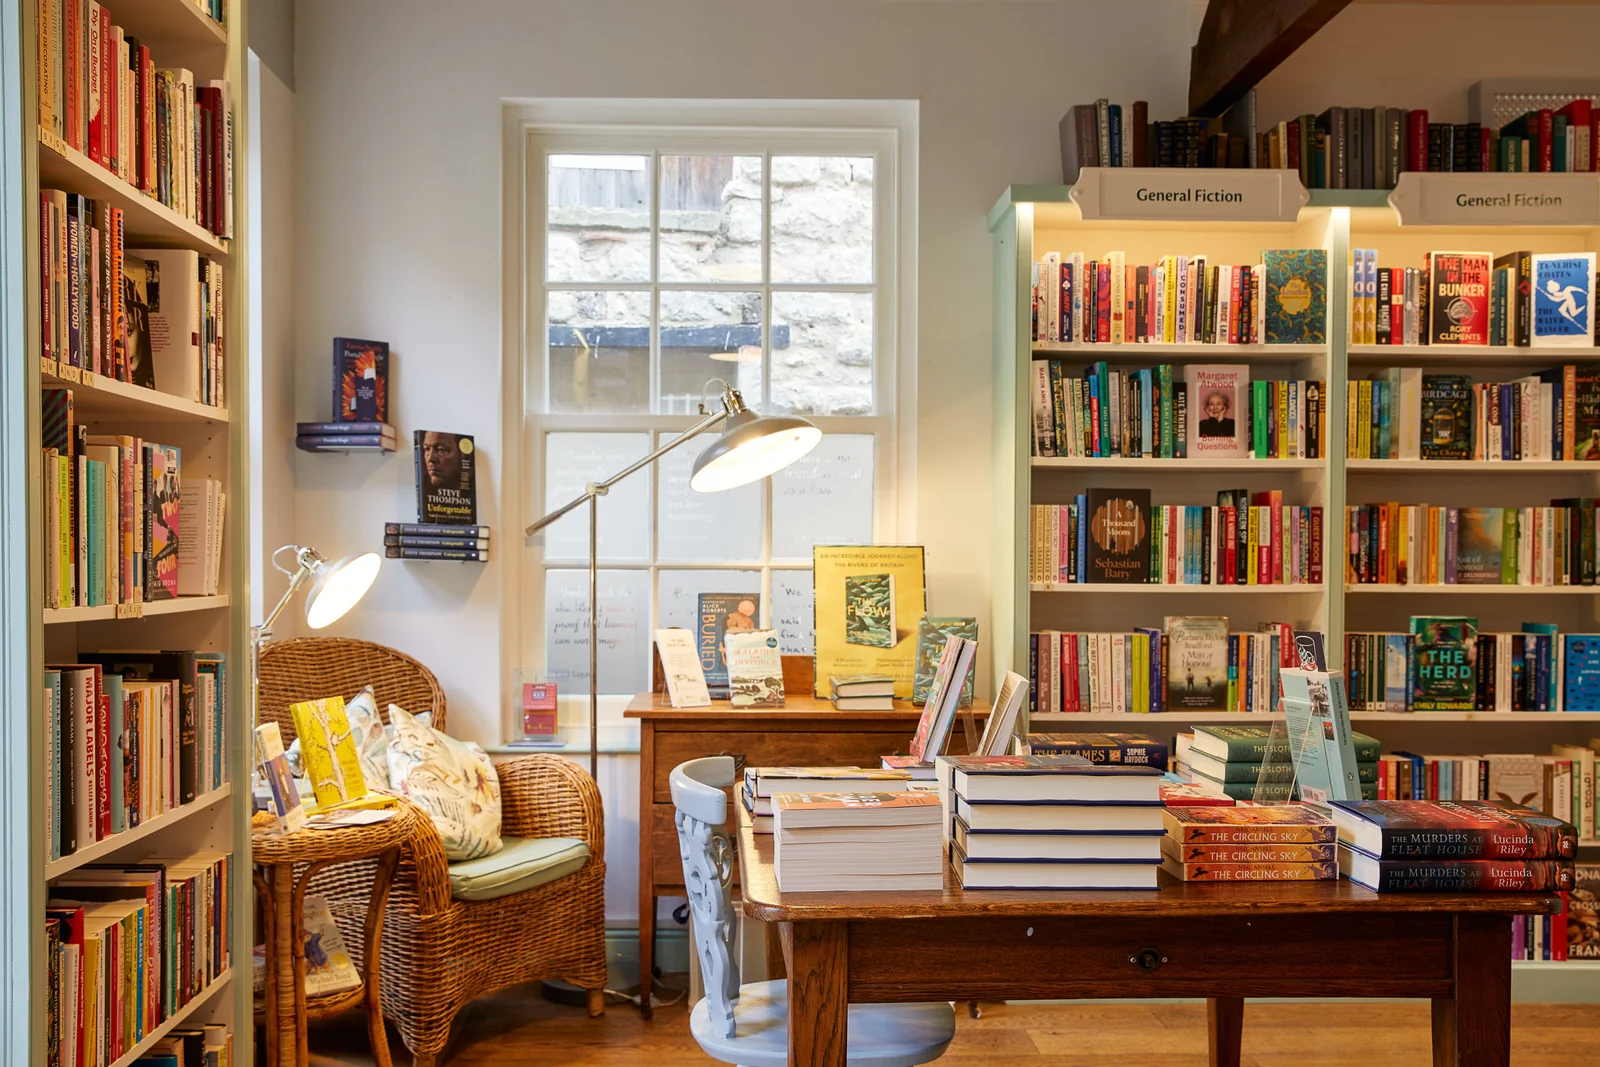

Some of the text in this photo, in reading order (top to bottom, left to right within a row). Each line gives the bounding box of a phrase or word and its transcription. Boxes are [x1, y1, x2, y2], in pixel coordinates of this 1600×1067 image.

[1136, 188, 1244, 204] General Fiction
[1456, 194, 1562, 208] General Fiction
[70, 220, 78, 258] WOMEN
[1437, 258, 1489, 272] THE MAN
[1233, 268, 1241, 288] ROAR
[1446, 271, 1482, 284] IN THE
[1539, 271, 1572, 279] COATES
[1380, 272, 1389, 301] LEE CHILD
[1438, 283, 1486, 298] BUNKER
[71, 266, 79, 330] HOLLYWOOD
[1538, 307, 1553, 315] THE
[1538, 316, 1564, 325] WATER
[1449, 324, 1473, 334] RORY
[1537, 326, 1569, 334] DANCER
[1438, 332, 1482, 342] CLEMENTS
[1038, 367, 1046, 389] MARTIN
[1196, 370, 1238, 384] Margaret
[1198, 379, 1236, 389] Atwood
[1177, 391, 1186, 442] KATE ATKINSON
[1279, 407, 1287, 434] BONES
[1196, 442, 1238, 452] Questions
[437, 488, 462, 498] STEVE
[427, 494, 471, 505] THOMPSON
[427, 503, 472, 515] Unforgettable
[1115, 510, 1122, 519] A
[1100, 518, 1137, 528] Thousand
[1238, 497, 1248, 544] NORTHERN SPY
[1105, 526, 1132, 537] Moons
[1312, 516, 1320, 563] GUEST BOOK
[1094, 558, 1142, 570] Sebastian
[1103, 568, 1132, 580] Barry
[856, 596, 876, 606] THE
[847, 605, 888, 618] FLOW
[582, 618, 602, 630] tht
[1171, 630, 1225, 643] Barbara Taylor
[701, 614, 716, 671] BURIED
[733, 648, 775, 656] WALKING
[1188, 651, 1205, 659] Man
[1206, 652, 1214, 661] of
[1427, 650, 1464, 664] THE
[1182, 659, 1212, 668] Honour
[1419, 665, 1472, 679] HERD
[207, 705, 212, 714] OF
[1414, 701, 1473, 710] EMILY EDWARDS
[85, 676, 94, 777] MAJOR LABELS
[1126, 748, 1147, 756] SOPHIE
[1124, 755, 1149, 764] HAYDOCK
[1251, 766, 1292, 774] THE SLOTH
[1249, 787, 1290, 795] THE SLOTH
[1209, 832, 1299, 842] THE CIRCLING SKY
[1390, 833, 1484, 844] THE MURDERS AT
[1492, 834, 1535, 845] Lucinda
[1390, 844, 1483, 856] FLEAT HOUSE
[1499, 845, 1527, 857] Riley
[1209, 851, 1298, 861] THE CIRCLING SKY
[1212, 870, 1301, 880] THE CIRCLING SKY
[1388, 868, 1482, 878] THE MURDERS AT
[1490, 867, 1533, 878] Lucinda
[1388, 878, 1481, 889] FLEAT HOUSE
[1498, 878, 1526, 889] Riley
